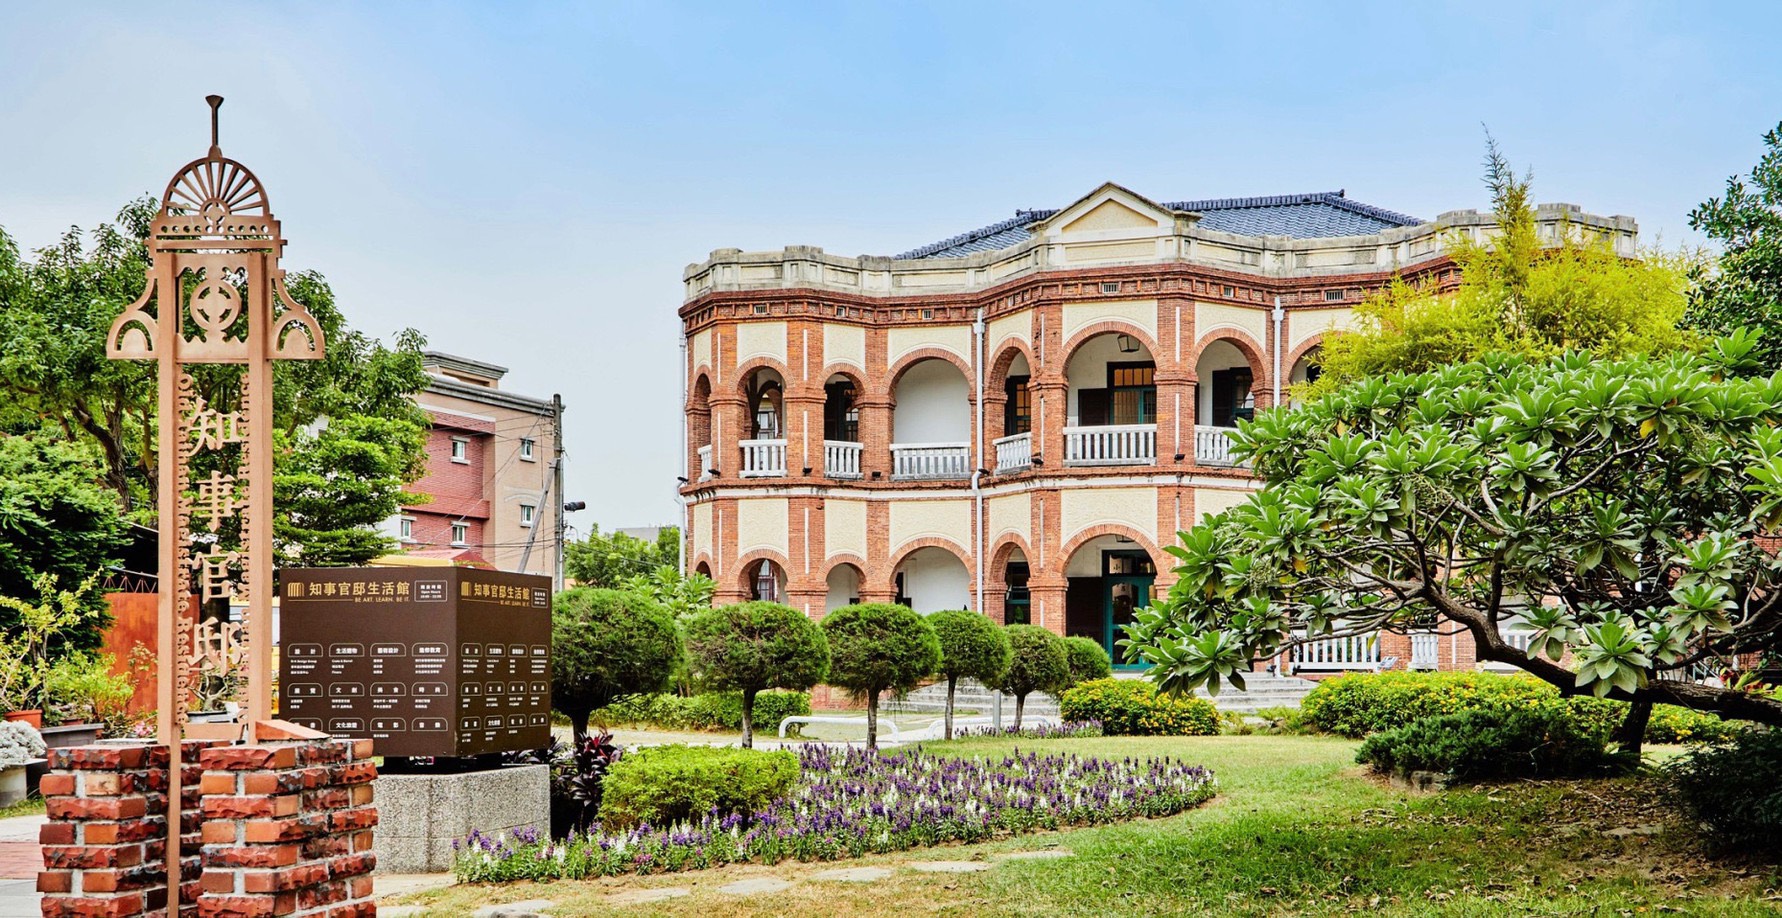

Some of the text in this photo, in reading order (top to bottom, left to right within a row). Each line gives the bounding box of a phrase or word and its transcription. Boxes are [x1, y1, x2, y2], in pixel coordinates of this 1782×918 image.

[187, 396, 246, 677] 知事官邸
[309, 581, 410, 596] 知事官邸生活館
[474, 583, 530, 600] 知事官邸生活館
